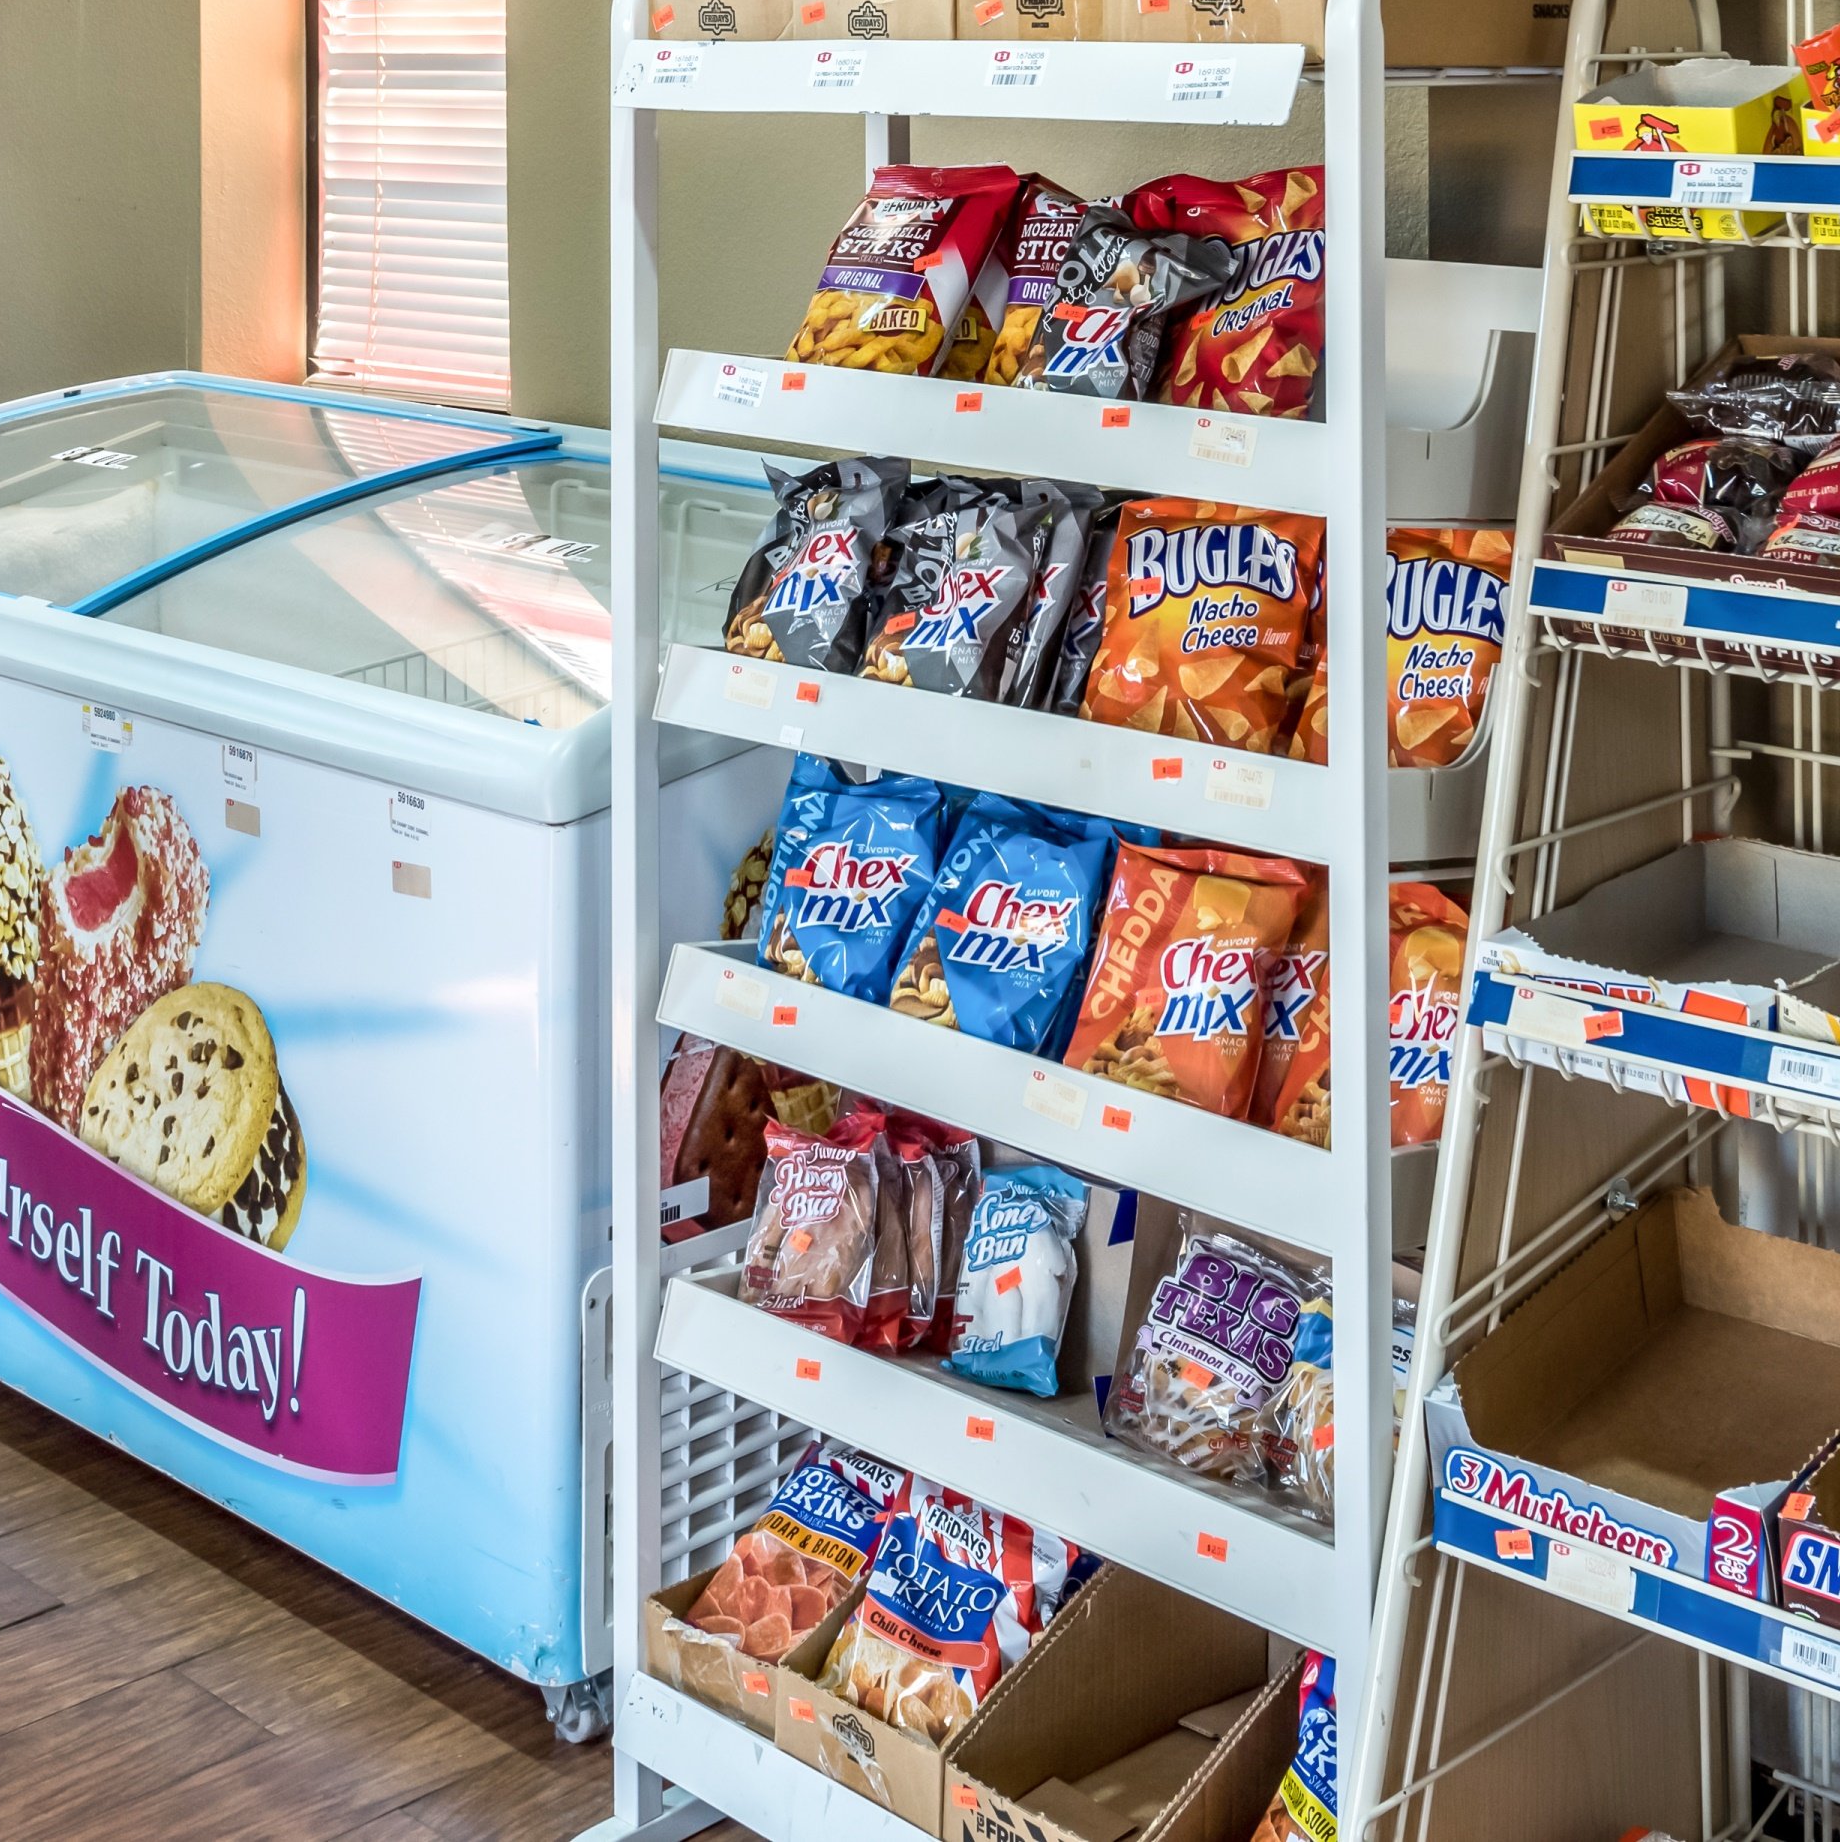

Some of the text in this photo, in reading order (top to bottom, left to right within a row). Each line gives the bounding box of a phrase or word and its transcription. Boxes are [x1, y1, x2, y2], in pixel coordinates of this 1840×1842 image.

[1710, 167, 1747, 175] 1660976
[837, 238, 925, 259] STICKS
[835, 270, 881, 289] ORIGINAL
[870, 310, 919, 330] BAKED
[1091, 366, 1126, 380] SNACK
[1098, 378, 1117, 387] MIX
[1128, 524, 1299, 617] BUGLES
[1190, 593, 1260, 627] Nacho
[952, 646, 984, 655] SNACK
[1181, 626, 1291, 653] Cheese flavor
[958, 655, 976, 664] MIX
[1405, 643, 1473, 671] Nacho
[1398, 673, 1473, 701] Cheese
[804, 842, 913, 889] Chex
[799, 887, 893, 930] mix
[966, 883, 1075, 935] Chex
[1025, 889, 1060, 898] SAVORY
[952, 930, 1062, 971] mix
[1216, 937, 1258, 948] SAVORY
[1010, 972, 1043, 982] SNACK
[1163, 943, 1262, 989] Chex
[1012, 979, 1032, 988] MIX
[1159, 989, 1254, 1036] mix
[1214, 1036, 1248, 1047] SNACK
[1220, 1047, 1238, 1056] MIX
[786, 1193, 840, 1222] Bun
[968, 1195, 1051, 1235] Honey
[970, 1236, 1025, 1266] Bun
[1181, 1253, 1300, 1336] BIG
[133, 1247, 308, 1424] Today!
[1154, 1281, 1292, 1382] TEXAS
[1159, 1330, 1254, 1390] Cinnamon Roll
[779, 1482, 865, 1531] SKINS
[1455, 1458, 1667, 1567] 3 Musketeers
[798, 1532, 855, 1571] & BACON
[1712, 1516, 1756, 1562] 2
[878, 1534, 998, 1612] POTATO
[891, 1595, 944, 1633] SNACK CHIPS
[870, 1610, 942, 1658] Chili Cheese
